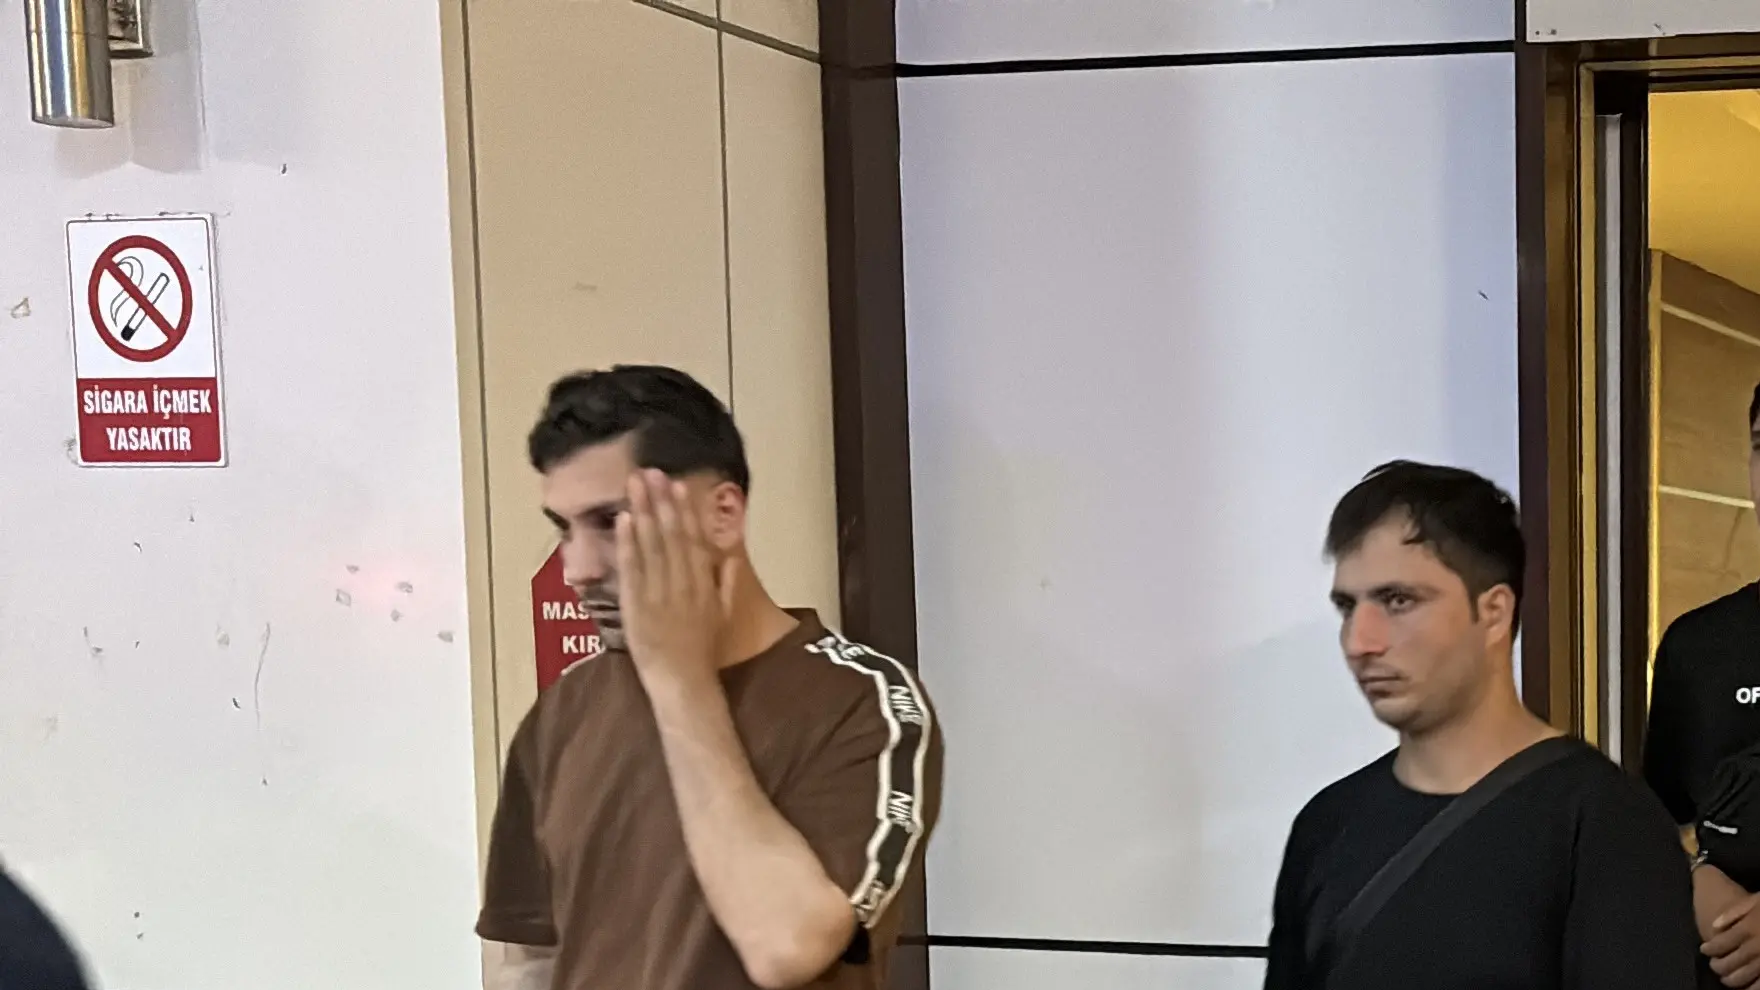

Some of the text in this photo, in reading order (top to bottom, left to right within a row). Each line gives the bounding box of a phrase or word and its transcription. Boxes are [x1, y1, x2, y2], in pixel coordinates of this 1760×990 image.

[83, 383, 212, 420] SİGARA İÇMEK
[106, 426, 192, 451] YASAKTIR
[562, 634, 606, 654] KIR
